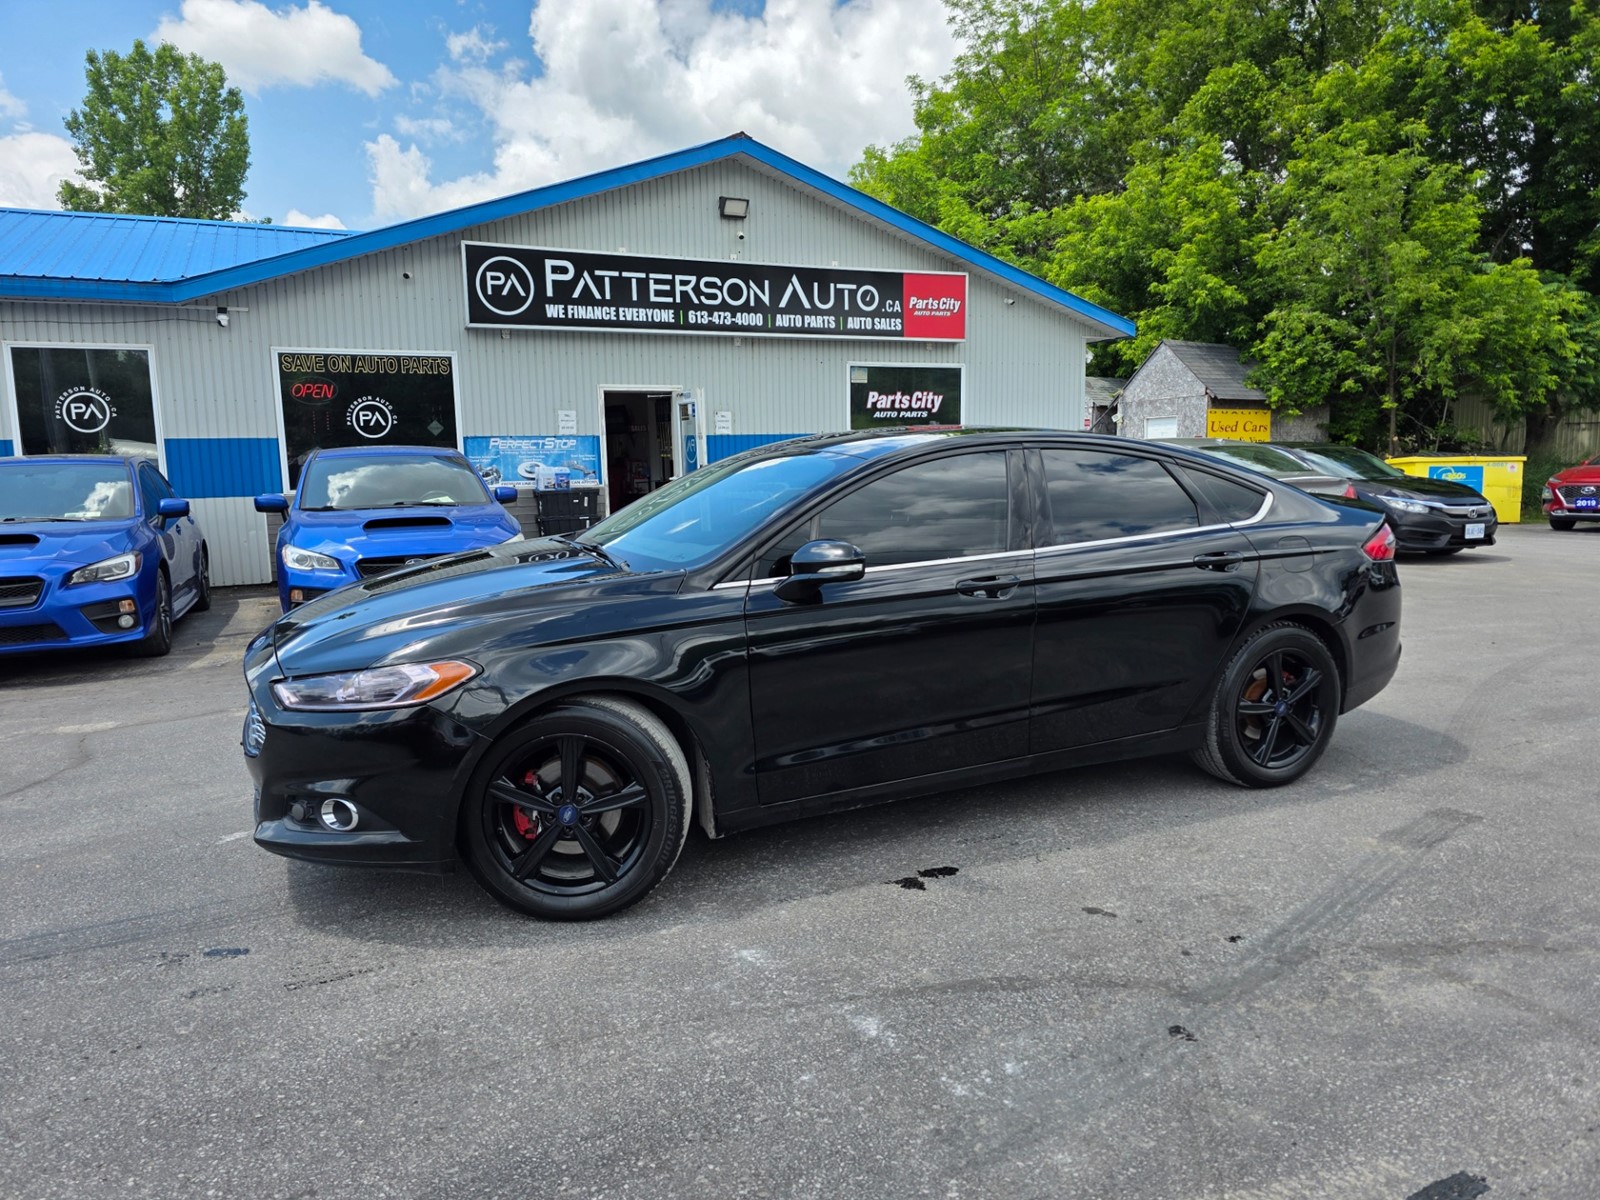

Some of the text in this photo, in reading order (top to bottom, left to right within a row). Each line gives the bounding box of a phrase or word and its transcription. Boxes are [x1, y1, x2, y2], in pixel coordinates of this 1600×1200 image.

[485, 271, 526, 297] PA
[544, 258, 770, 307] PATTERSON
[778, 273, 880, 312] AUTO
[545, 304, 902, 331] WE FINANCE EVERYONE 613-473-4000 AUTO PARTS AUTO SALES
[282, 354, 450, 374] SAVE ON AUTO PARTS
[291, 383, 334, 398] OPEN
[55, 386, 85, 419] PATTERSON
[89, 387, 111, 401] AUTO
[70, 403, 103, 420] PA
[346, 395, 373, 426] PATTERSON
[375, 396, 394, 411] AUTO
[359, 411, 386, 426] PA
[1211, 420, 1269, 433] Used Cars
[1576, 499, 1597, 507] 2019
